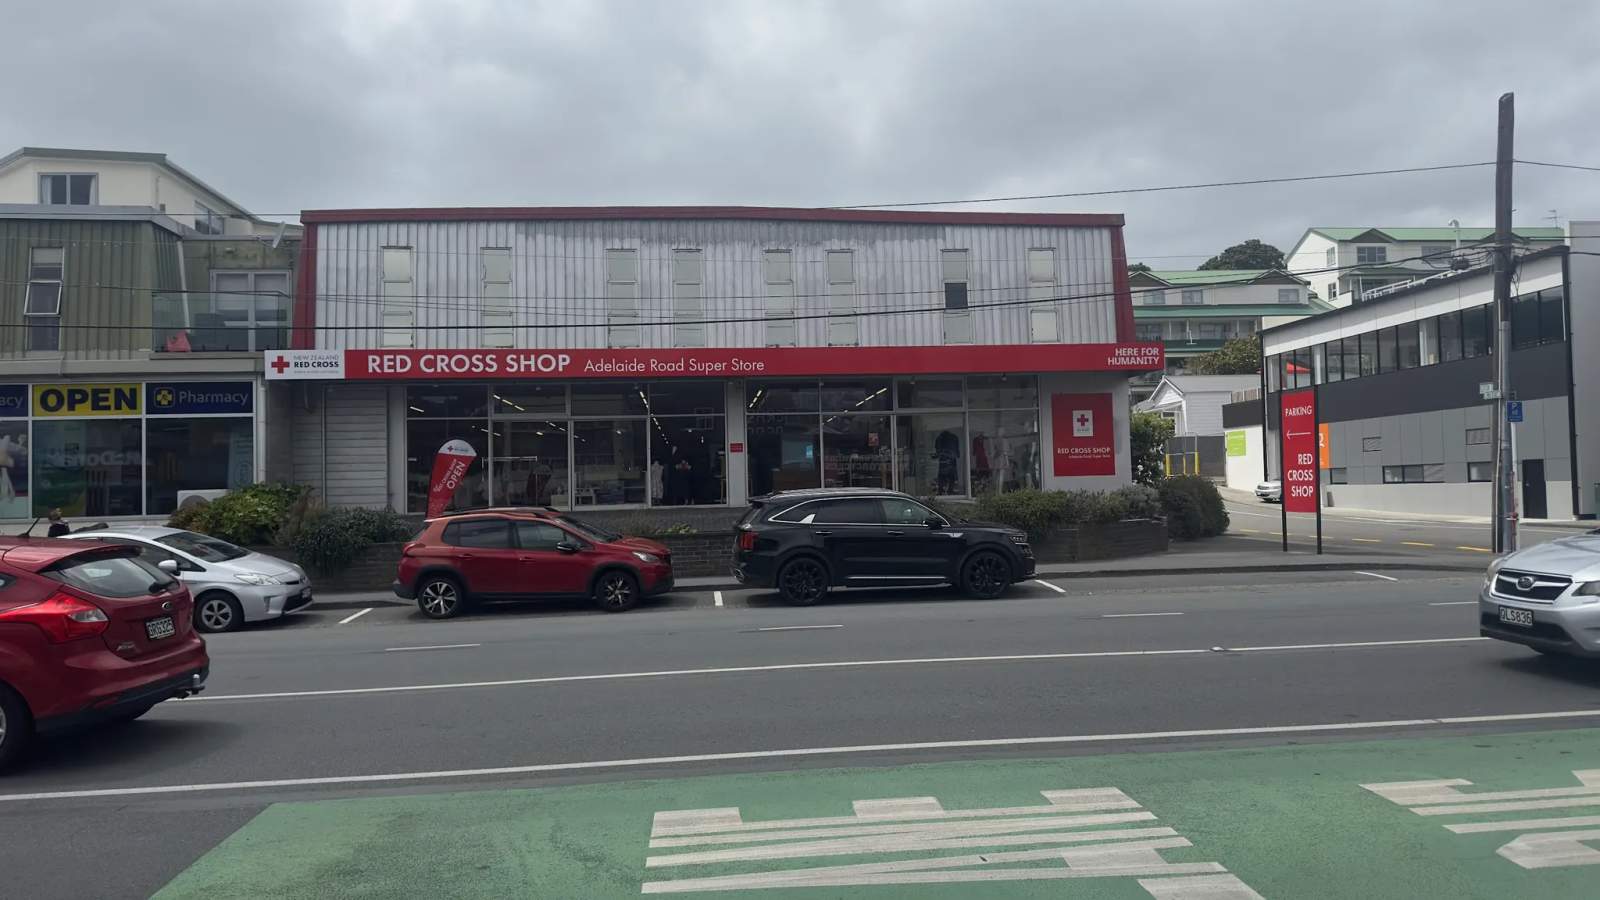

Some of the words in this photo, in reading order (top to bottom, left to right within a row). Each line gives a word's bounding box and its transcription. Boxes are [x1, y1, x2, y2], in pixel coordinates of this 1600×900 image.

[1115, 347, 1139, 356] HERE
[1141, 347, 1160, 356] FOR
[367, 354, 412, 373] RED
[419, 354, 498, 373] CROSS
[505, 354, 571, 372] SHOP
[584, 359, 646, 372] Adelaide
[650, 358, 684, 371] Road
[689, 359, 727, 374] Super
[731, 358, 765, 371] Store
[1107, 356, 1160, 365] HUMANITY
[39, 387, 138, 412] OPEN
[178, 391, 249, 405] Pharmacy
[1285, 405, 1313, 416] PARKING
[1297, 453, 1313, 465] RED
[446, 461, 465, 489] OPEN
[1287, 469, 1314, 481] CROSS
[1291, 485, 1314, 497] SHOP
